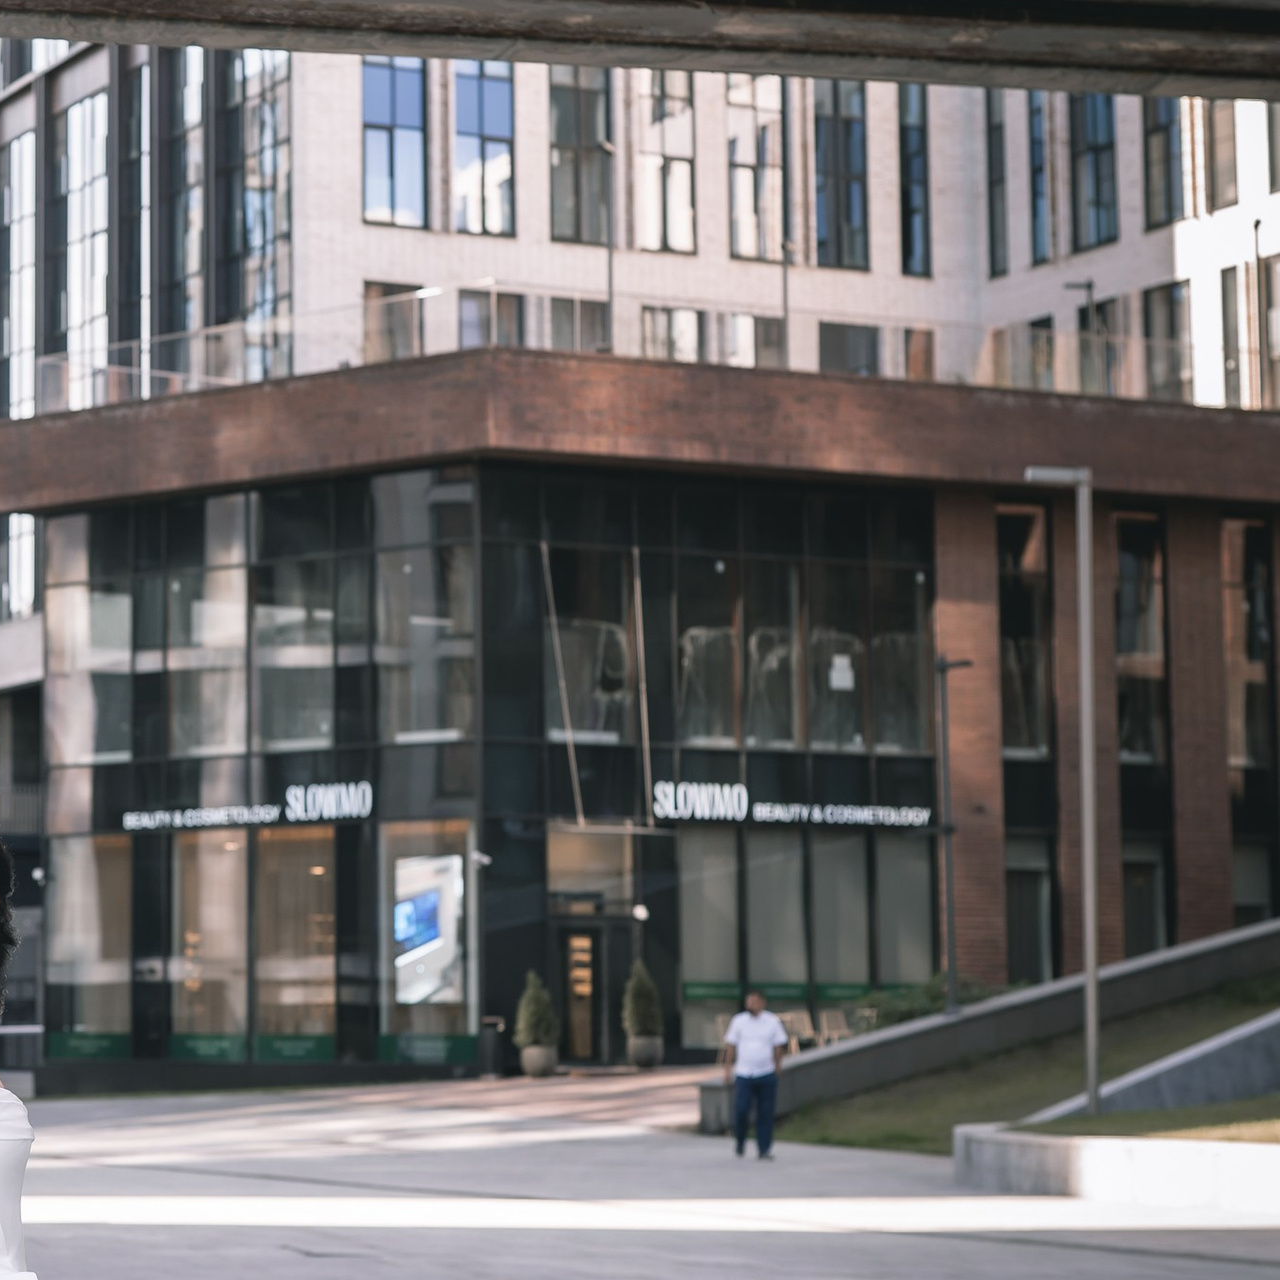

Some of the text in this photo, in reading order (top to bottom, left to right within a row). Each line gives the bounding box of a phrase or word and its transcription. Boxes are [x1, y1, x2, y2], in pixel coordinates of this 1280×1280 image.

[123, 781, 373, 830] BEAUTY & COSMETOLOGY SLOWMO
[653, 780, 931, 826] SLOWMO BEAUTY & COSMETOLOGY
